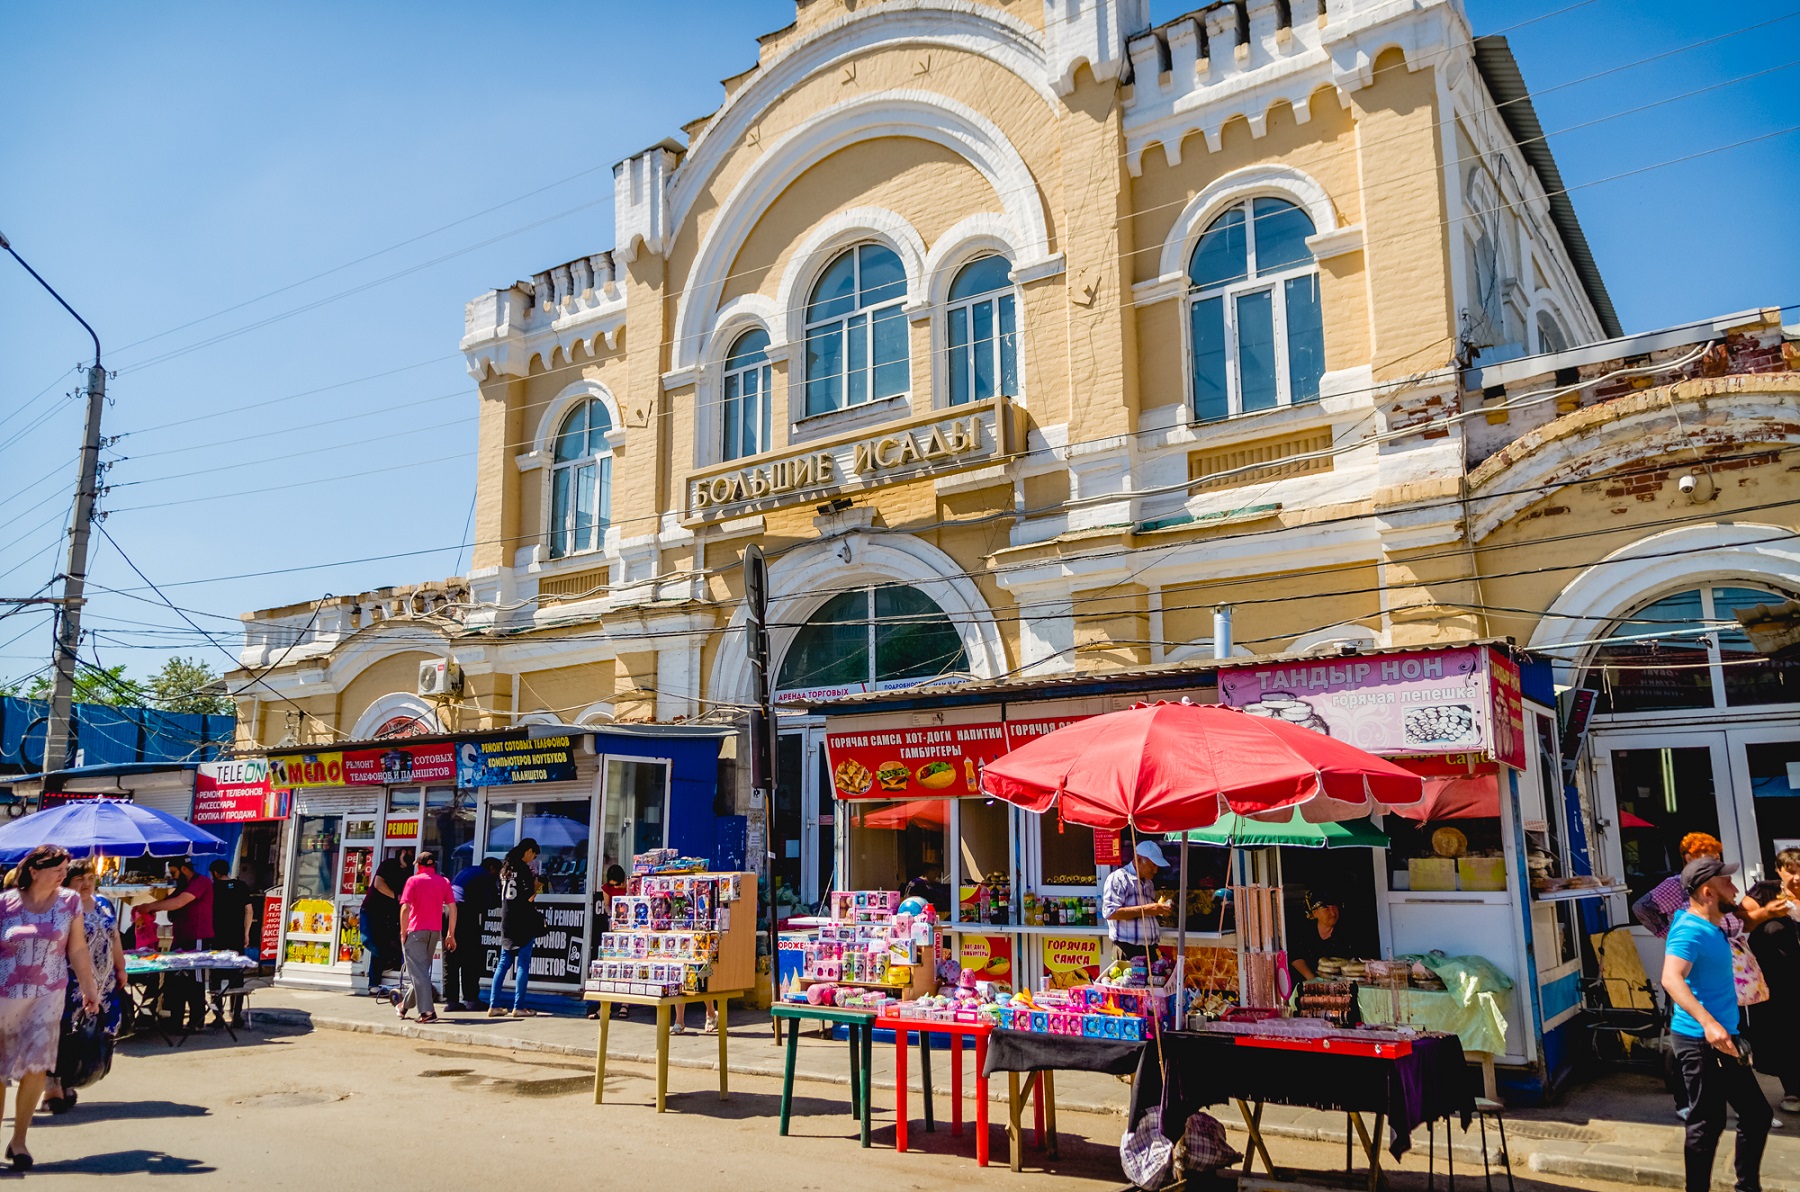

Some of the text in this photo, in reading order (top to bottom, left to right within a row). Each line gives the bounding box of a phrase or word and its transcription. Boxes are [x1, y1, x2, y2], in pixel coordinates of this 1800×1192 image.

[696, 416, 982, 508] БОЛЬШИЕ ИСАДЫ
[1255, 657, 1443, 690] ТАНДЫР НОН
[778, 689, 849, 701] АРЕНДА ТОРГОВЫХ
[1331, 686, 1477, 707] горячая лепешка
[1010, 722, 1056, 736] ГОРЯЧАЯ
[481, 736, 570, 753] РЕМОНТ СОТОВЫХ ТЕЛЕФОНОВ
[830, 727, 1003, 749] ГОРЯЧАЯ САМСА ХОТ-ДОГИ НАПИТКИ
[900, 746, 962, 759] ГАМБУРГЕРЫ
[345, 753, 453, 769] РЕМОНТ СОТОВЫХ
[488, 752, 568, 768] КОМПЬЮТЕРОВ НОУТБУКОВ
[350, 767, 450, 781] ТЕЛЕФОНОВ И ПЛАНШЕТОВ
[511, 769, 548, 781] ПЛАНШЕТОВ
[199, 788, 263, 799] РЕМОНТ ТЕЛЕФОНОВ
[199, 801, 237, 810] АКСЕССУАРЫ
[197, 812, 220, 820] СКУПКА
[226, 810, 257, 820] ПРОДАЖА
[387, 822, 418, 835] РЕМОНТ
[553, 909, 584, 927] РЕМОНТ
[533, 930, 567, 949] ФОНОВ
[777, 940, 805, 950] ОРОЖЕ
[1047, 940, 1096, 952] ГОРЯЧАЯ
[1053, 953, 1090, 965] САМСА
